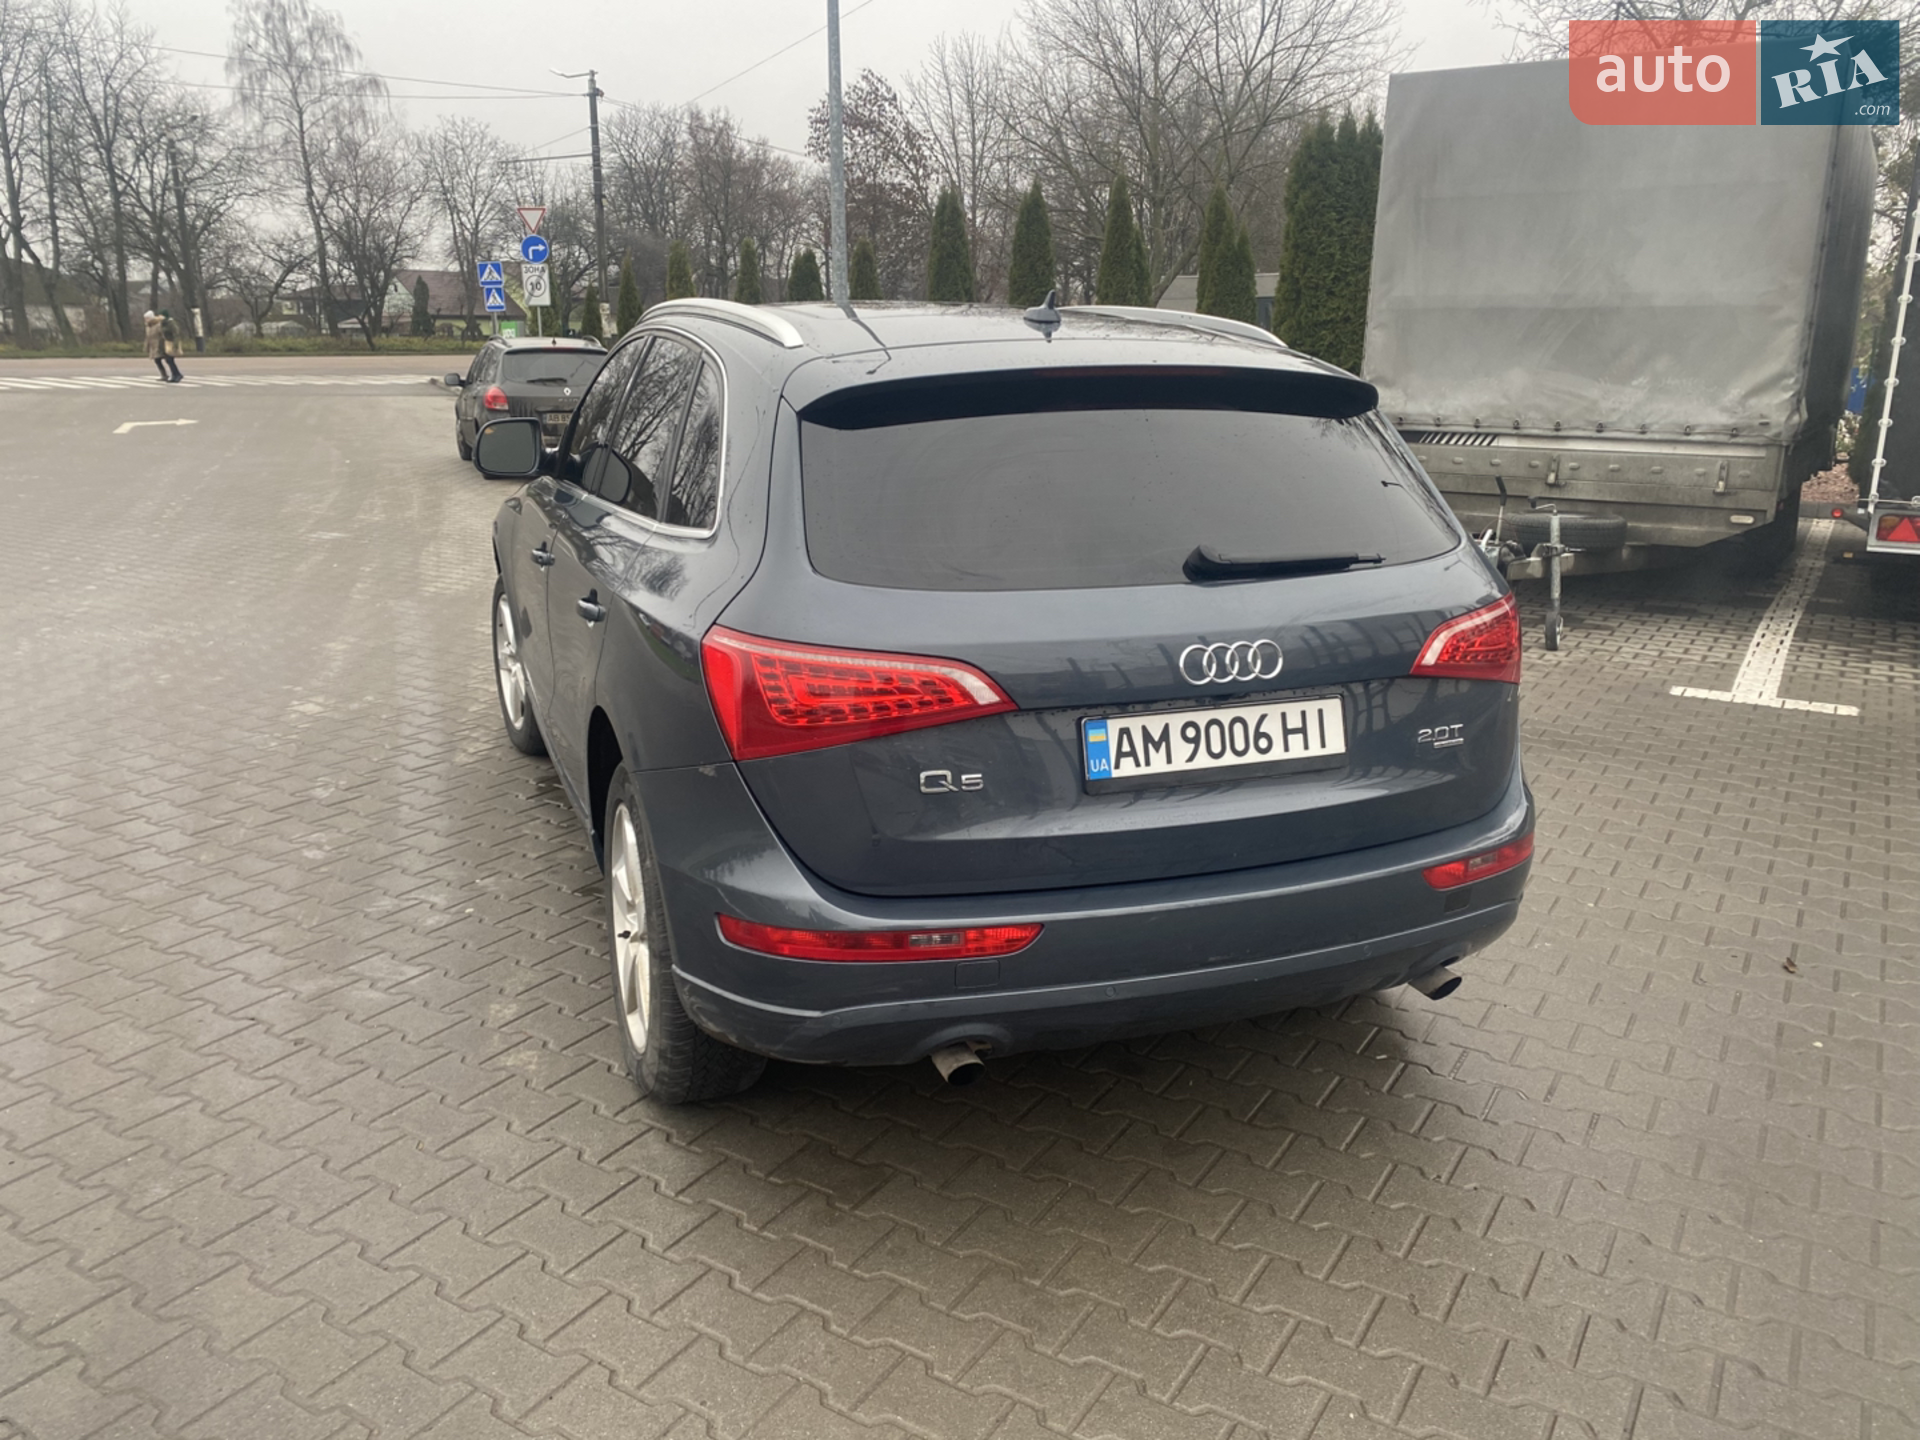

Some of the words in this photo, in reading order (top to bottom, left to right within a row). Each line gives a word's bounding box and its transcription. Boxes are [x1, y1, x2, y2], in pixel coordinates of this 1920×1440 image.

[523, 266, 546, 274] ЗОНА
[529, 281, 542, 291] 10
[1090, 758, 1109, 772] UA
[919, 769, 984, 793] Q5
